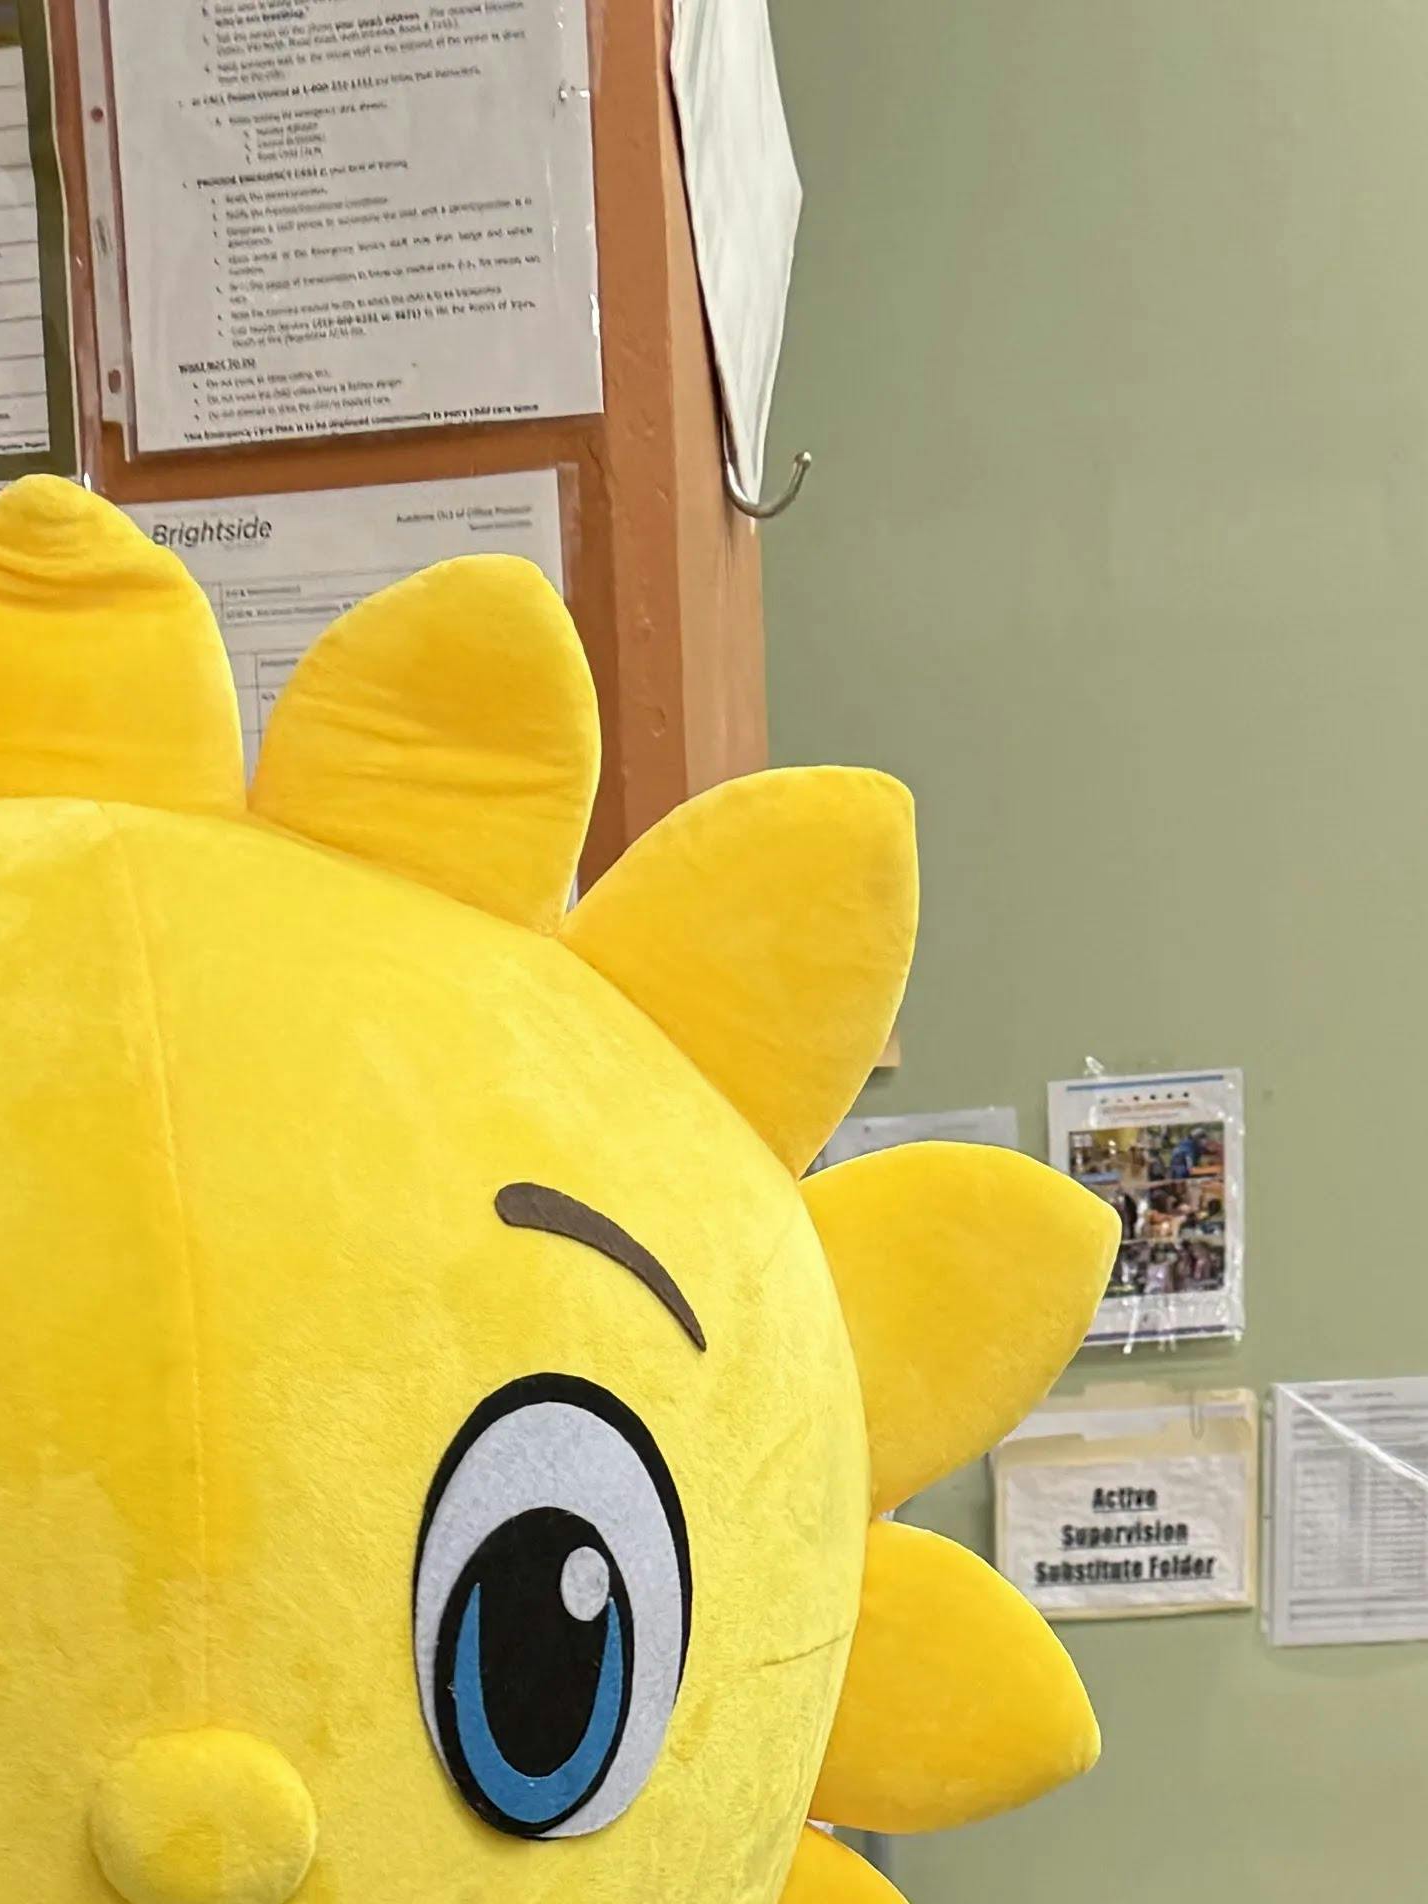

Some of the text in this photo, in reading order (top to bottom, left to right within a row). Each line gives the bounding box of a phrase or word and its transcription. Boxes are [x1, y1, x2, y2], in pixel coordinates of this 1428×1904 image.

[151, 515, 272, 548] Brightside
[1092, 1486, 1158, 1511] Active
[1061, 1520, 1189, 1548] Supervision
[1034, 1554, 1215, 1584] Substitute Folder
